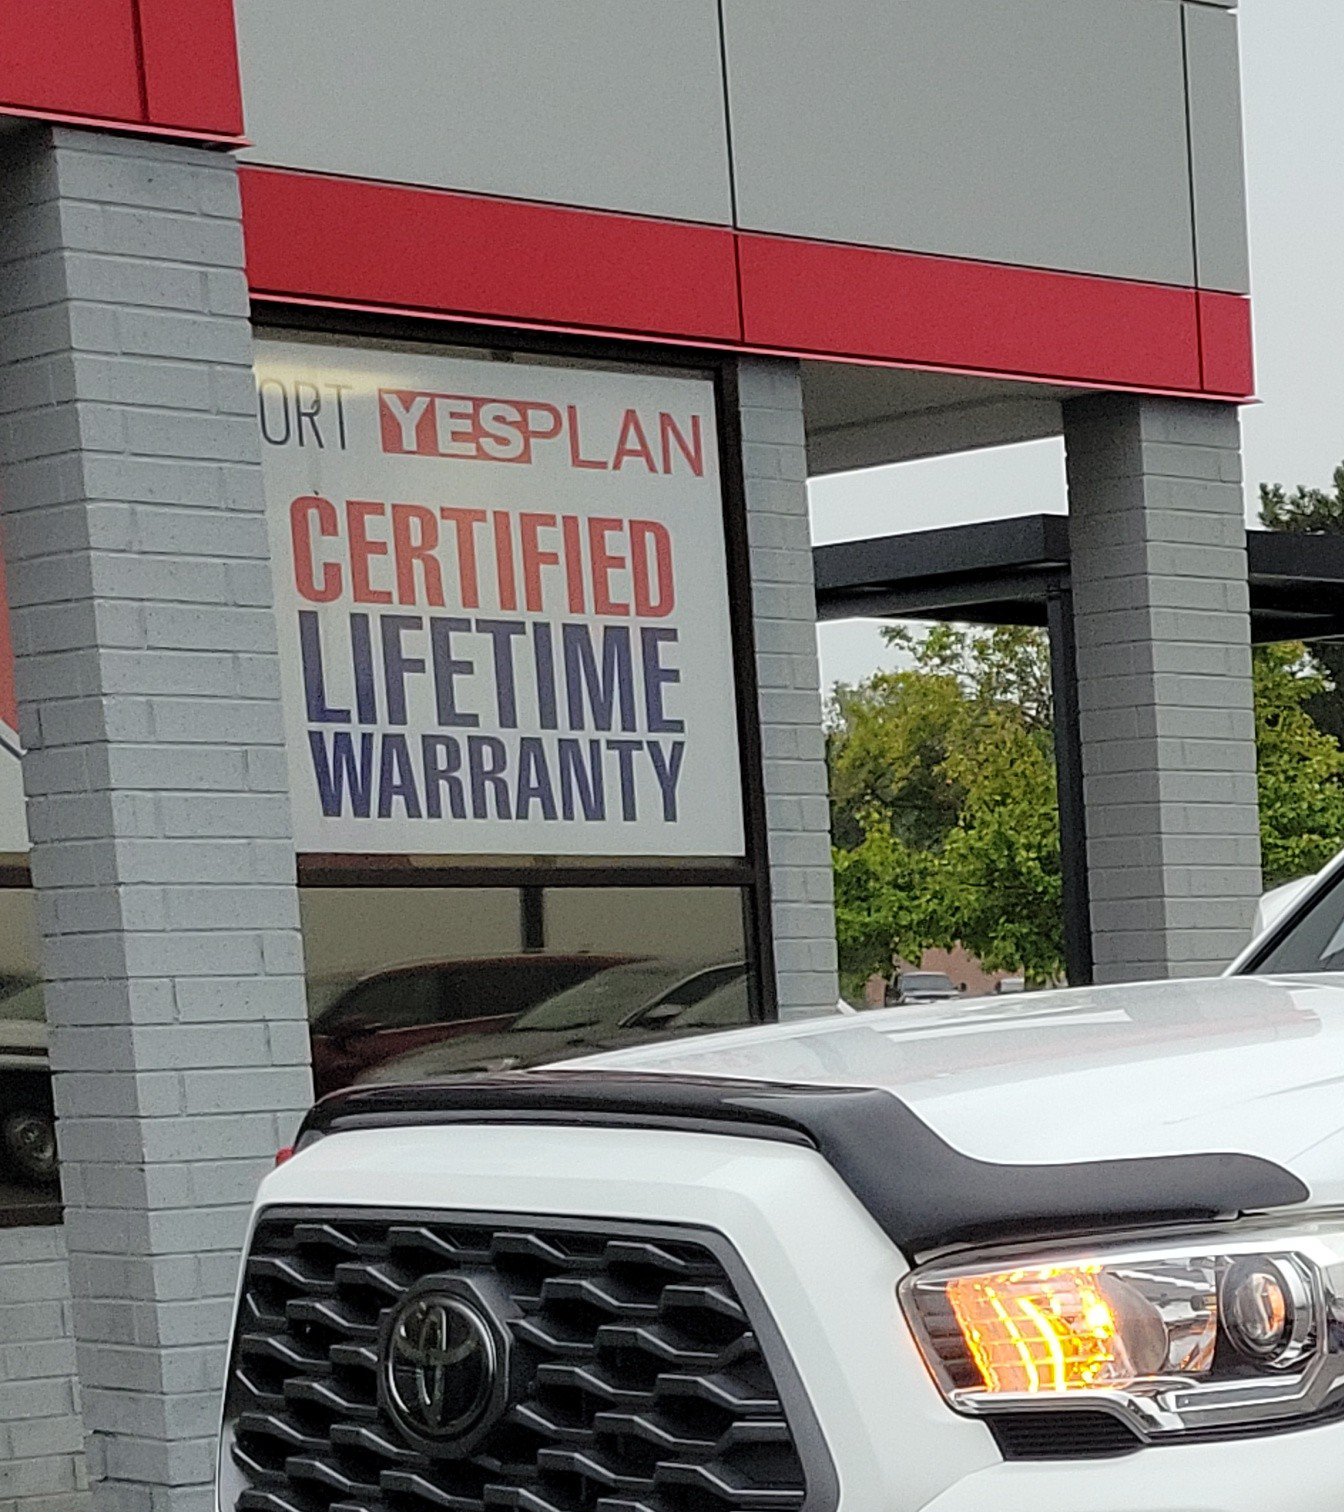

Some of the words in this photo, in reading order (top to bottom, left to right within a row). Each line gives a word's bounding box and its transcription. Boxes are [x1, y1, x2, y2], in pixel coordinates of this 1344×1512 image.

[290, 496, 674, 617] CERTIFIED
[298, 609, 685, 733] LIFETIME
[307, 730, 685, 822] WARRANTY
